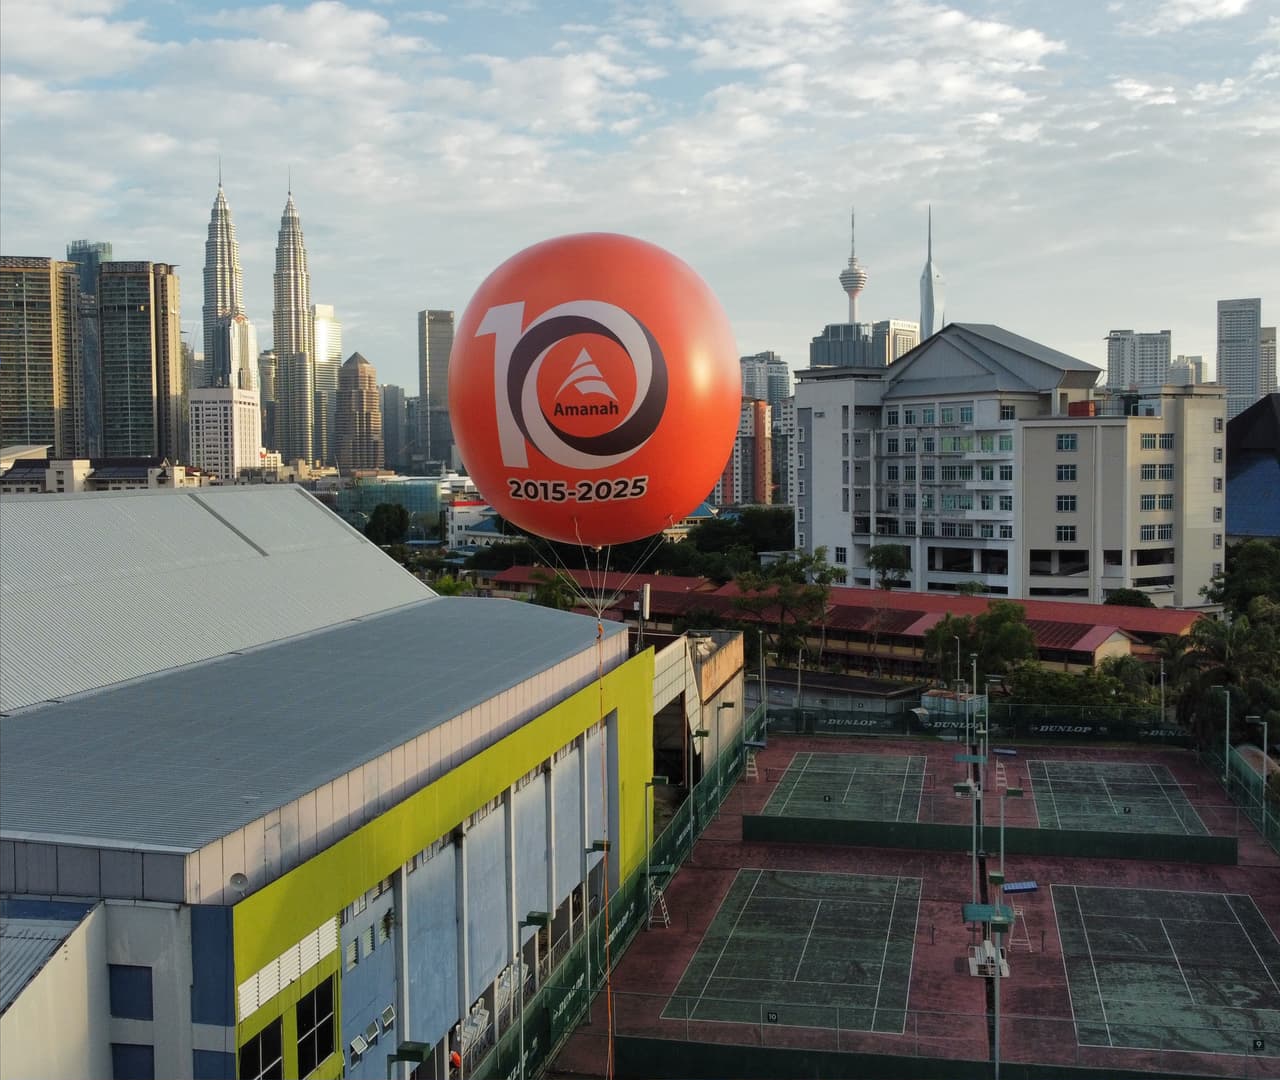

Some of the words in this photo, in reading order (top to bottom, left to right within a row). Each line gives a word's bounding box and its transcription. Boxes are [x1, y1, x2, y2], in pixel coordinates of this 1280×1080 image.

[554, 401, 619, 417] Amanah
[509, 478, 647, 501] 2015-2025
[828, 718, 878, 727] DUNLOP
[1039, 725, 1092, 734] DUNLOP
[768, 1013, 777, 1021] 10
